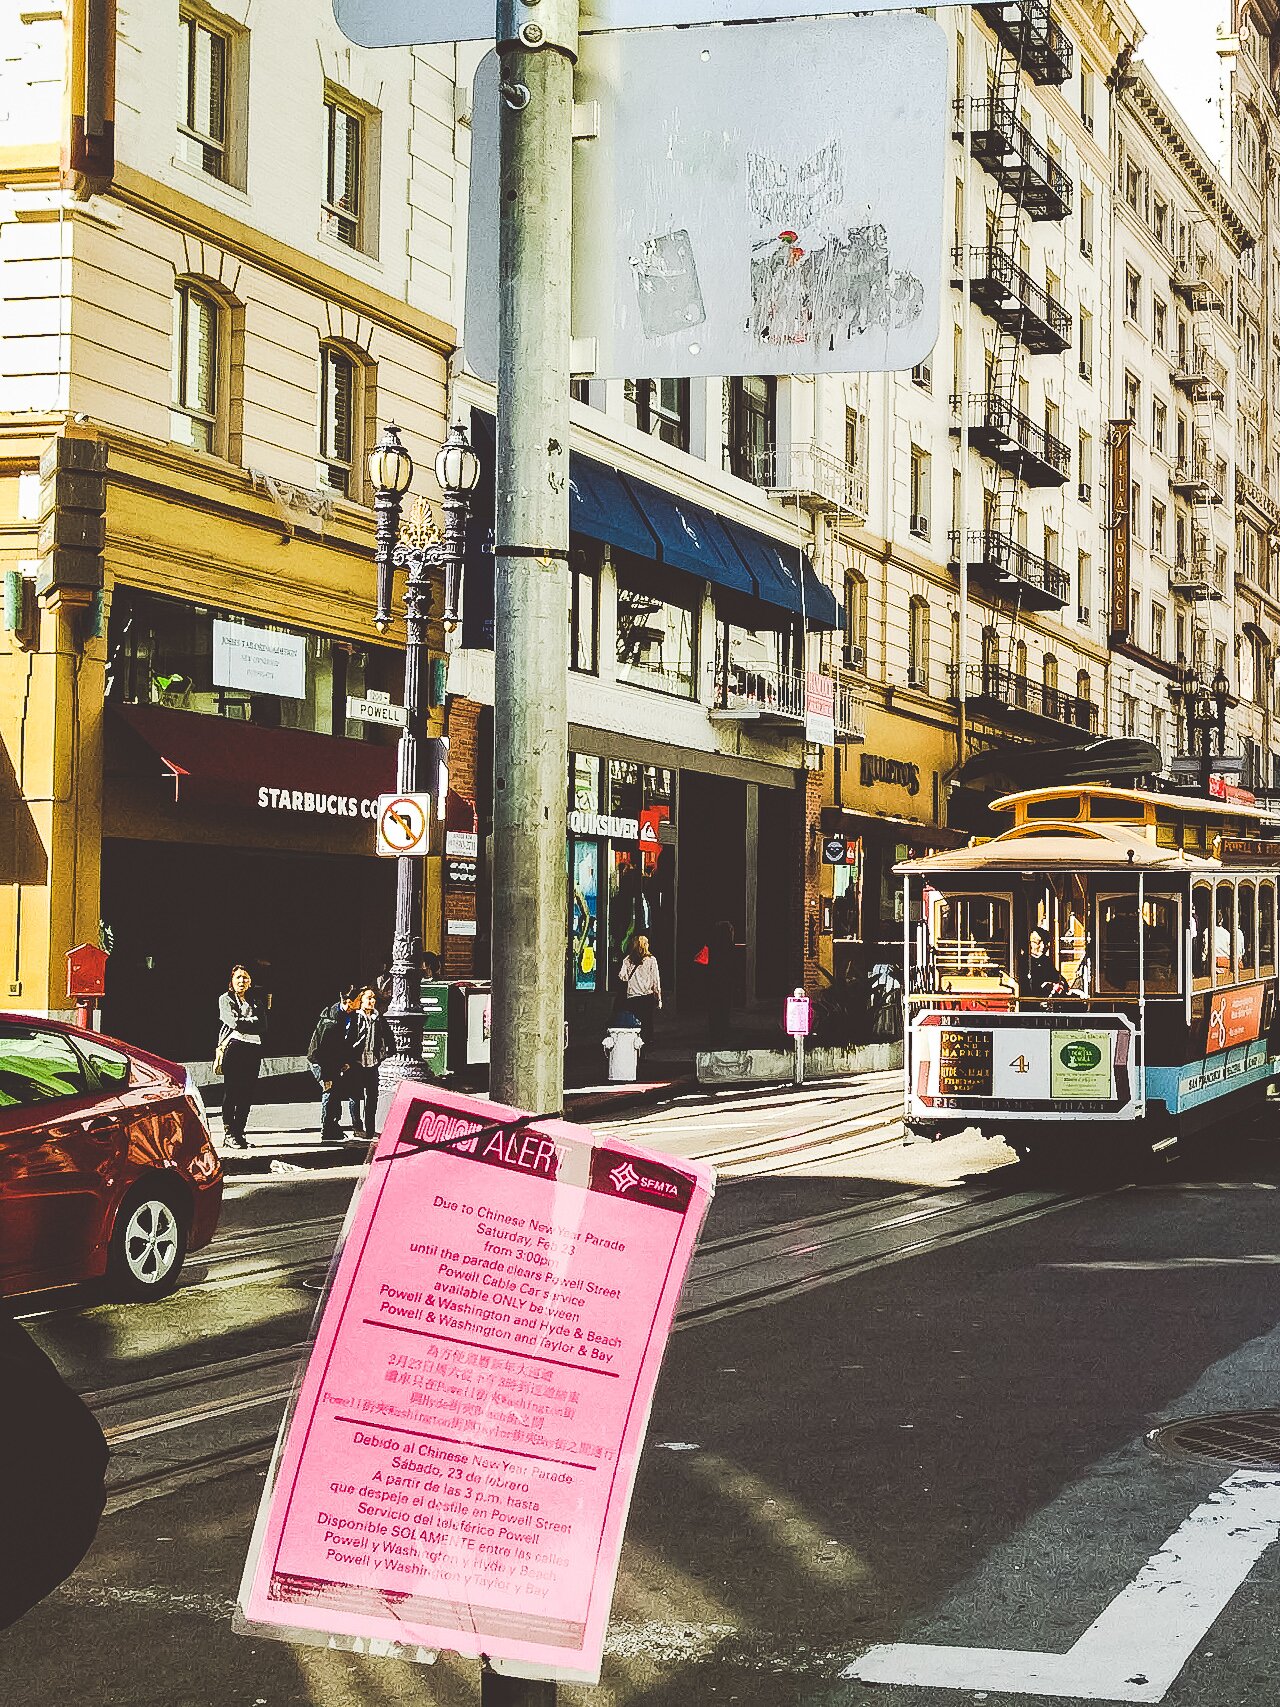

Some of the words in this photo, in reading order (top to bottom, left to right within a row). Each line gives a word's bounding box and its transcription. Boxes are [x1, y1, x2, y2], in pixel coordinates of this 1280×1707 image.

[1110, 429, 1130, 507] VILLA
[1111, 508, 1128, 626] FLORENCE
[361, 704, 400, 722] POWELL
[258, 786, 358, 818] STARBUCKS
[569, 811, 639, 839] QUIKSILVER
[1009, 1054, 1030, 1073] 4
[639, 1175, 679, 1197] SFMTA
[433, 1195, 459, 1212] Due
[462, 1203, 474, 1215] to
[477, 1206, 526, 1229] Chinese
[529, 1218, 554, 1235] New
[584, 1231, 626, 1252] Parade
[476, 1222, 533, 1248] Saturday,
[484, 1240, 513, 1257] from
[409, 1242, 438, 1256] until
[440, 1247, 459, 1262] the
[462, 1253, 505, 1273] parade
[507, 1263, 542, 1281] clears
[544, 1271, 584, 1291] Powell
[585, 1281, 622, 1300] Street
[438, 1263, 480, 1283] Powell
[482, 1274, 517, 1292] Cable
[519, 1283, 541, 1297] Car
[433, 1281, 490, 1302] available
[492, 1293, 527, 1310] ONLY
[379, 1283, 422, 1303] Powell
[424, 1293, 436, 1307] &
[437, 1296, 511, 1324] Washington
[513, 1313, 537, 1330] and
[539, 1319, 571, 1338] Hyde
[573, 1327, 584, 1340] &
[586, 1331, 623, 1349] Beach
[379, 1301, 422, 1321] Powell
[425, 1311, 436, 1324] &
[439, 1315, 512, 1342] Washington
[514, 1331, 538, 1347] and
[577, 1344, 588, 1358] &
[590, 1347, 614, 1365] Bay
[353, 1431, 400, 1451] Debido
[402, 1442, 416, 1455] al
[418, 1444, 469, 1465] Chinese
[372, 1470, 383, 1483] A
[385, 1474, 421, 1490] partir
[423, 1480, 440, 1493] de
[443, 1483, 462, 1498] las
[464, 1487, 473, 1499] 3
[506, 1496, 541, 1512] hasta
[447, 1467, 463, 1480] 23
[465, 1471, 482, 1484] de
[329, 1482, 355, 1497] que
[412, 1495, 424, 1507] el
[472, 1507, 488, 1519] en
[491, 1508, 533, 1528] Powell
[317, 1511, 389, 1540] Disponible
[478, 1543, 512, 1558] entre
[357, 1502, 411, 1523] Servicio
[413, 1512, 434, 1527] del
[498, 1526, 540, 1546] Powell
[323, 1530, 369, 1550] Powell
[371, 1541, 380, 1553] y
[326, 1548, 370, 1568] Powell
[373, 1558, 382, 1570] y
